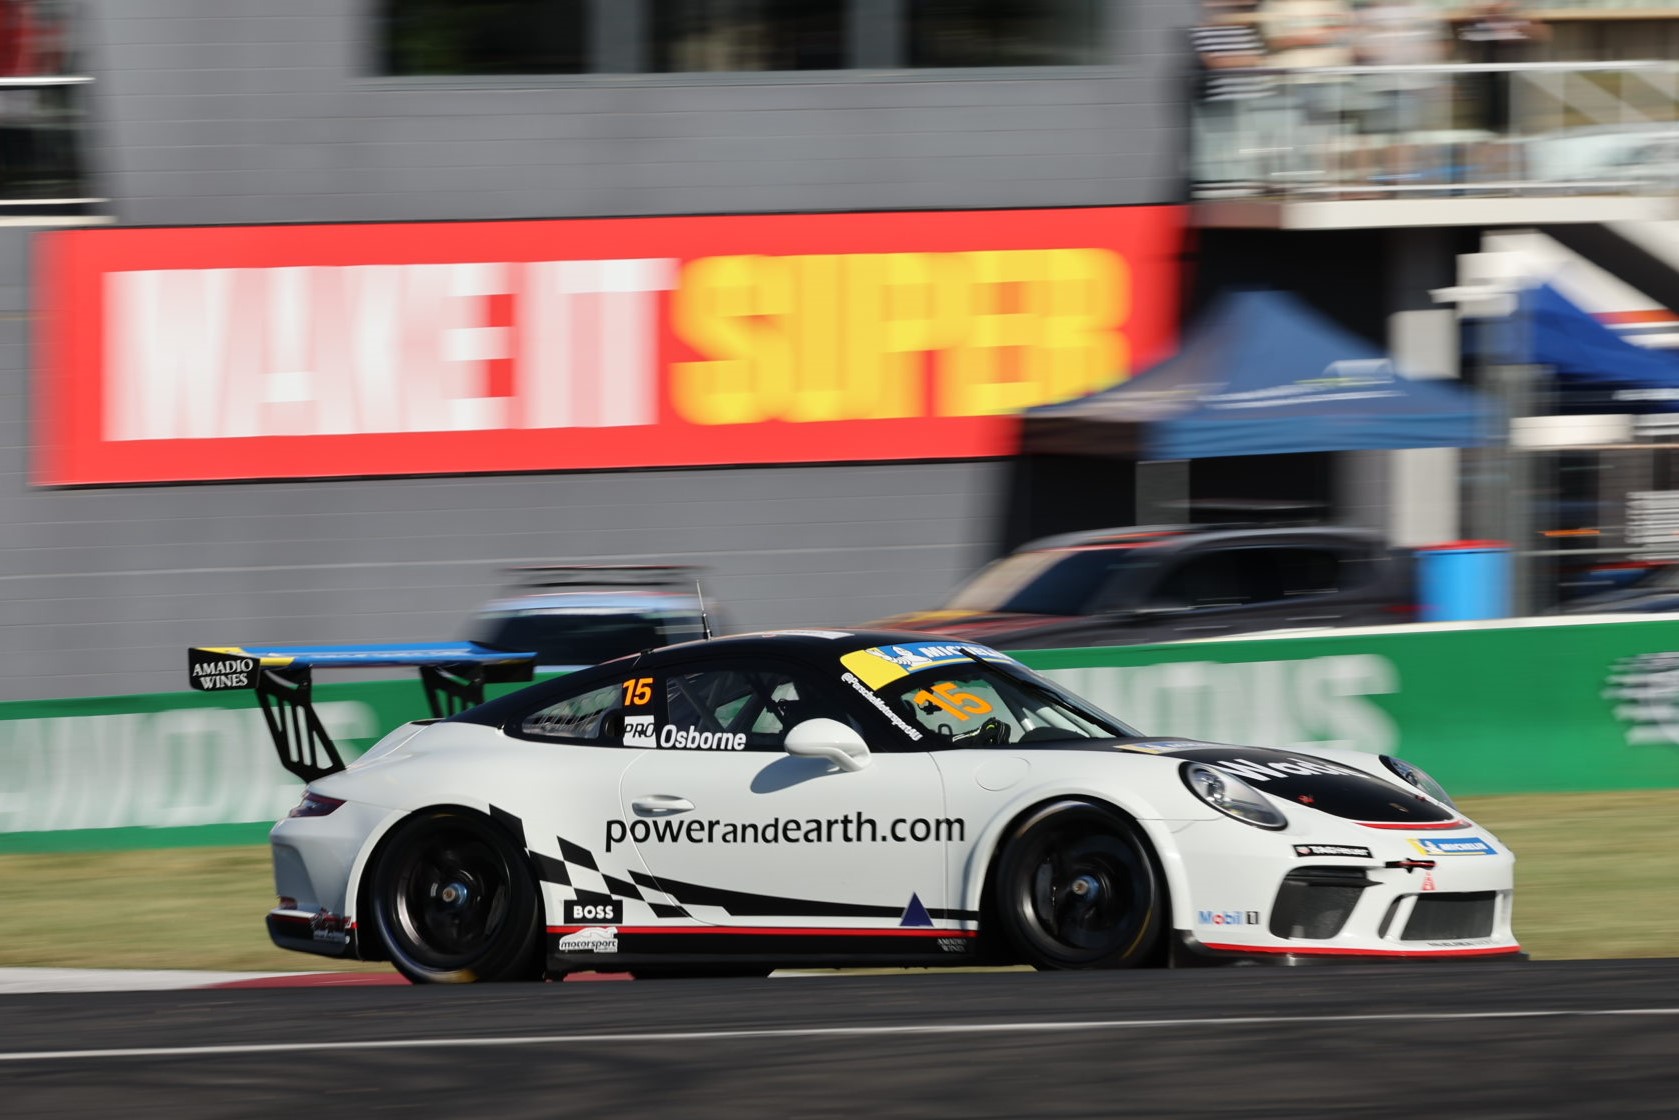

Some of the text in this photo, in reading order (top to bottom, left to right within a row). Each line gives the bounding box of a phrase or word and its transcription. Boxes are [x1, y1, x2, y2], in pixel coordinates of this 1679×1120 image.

[101, 248, 1131, 441] MAKE IT SUPER
[193, 659, 254, 676] AMADIO
[200, 673, 248, 690] WINES
[622, 677, 654, 706] 15
[913, 682, 993, 721] 15
[624, 723, 656, 738] PRO
[660, 724, 747, 751] Osborne
[605, 812, 965, 852] powerandearth.com
[573, 905, 614, 919] BOSS
[1198, 910, 1243, 925] Mobil
[561, 940, 617, 950] motorsport
